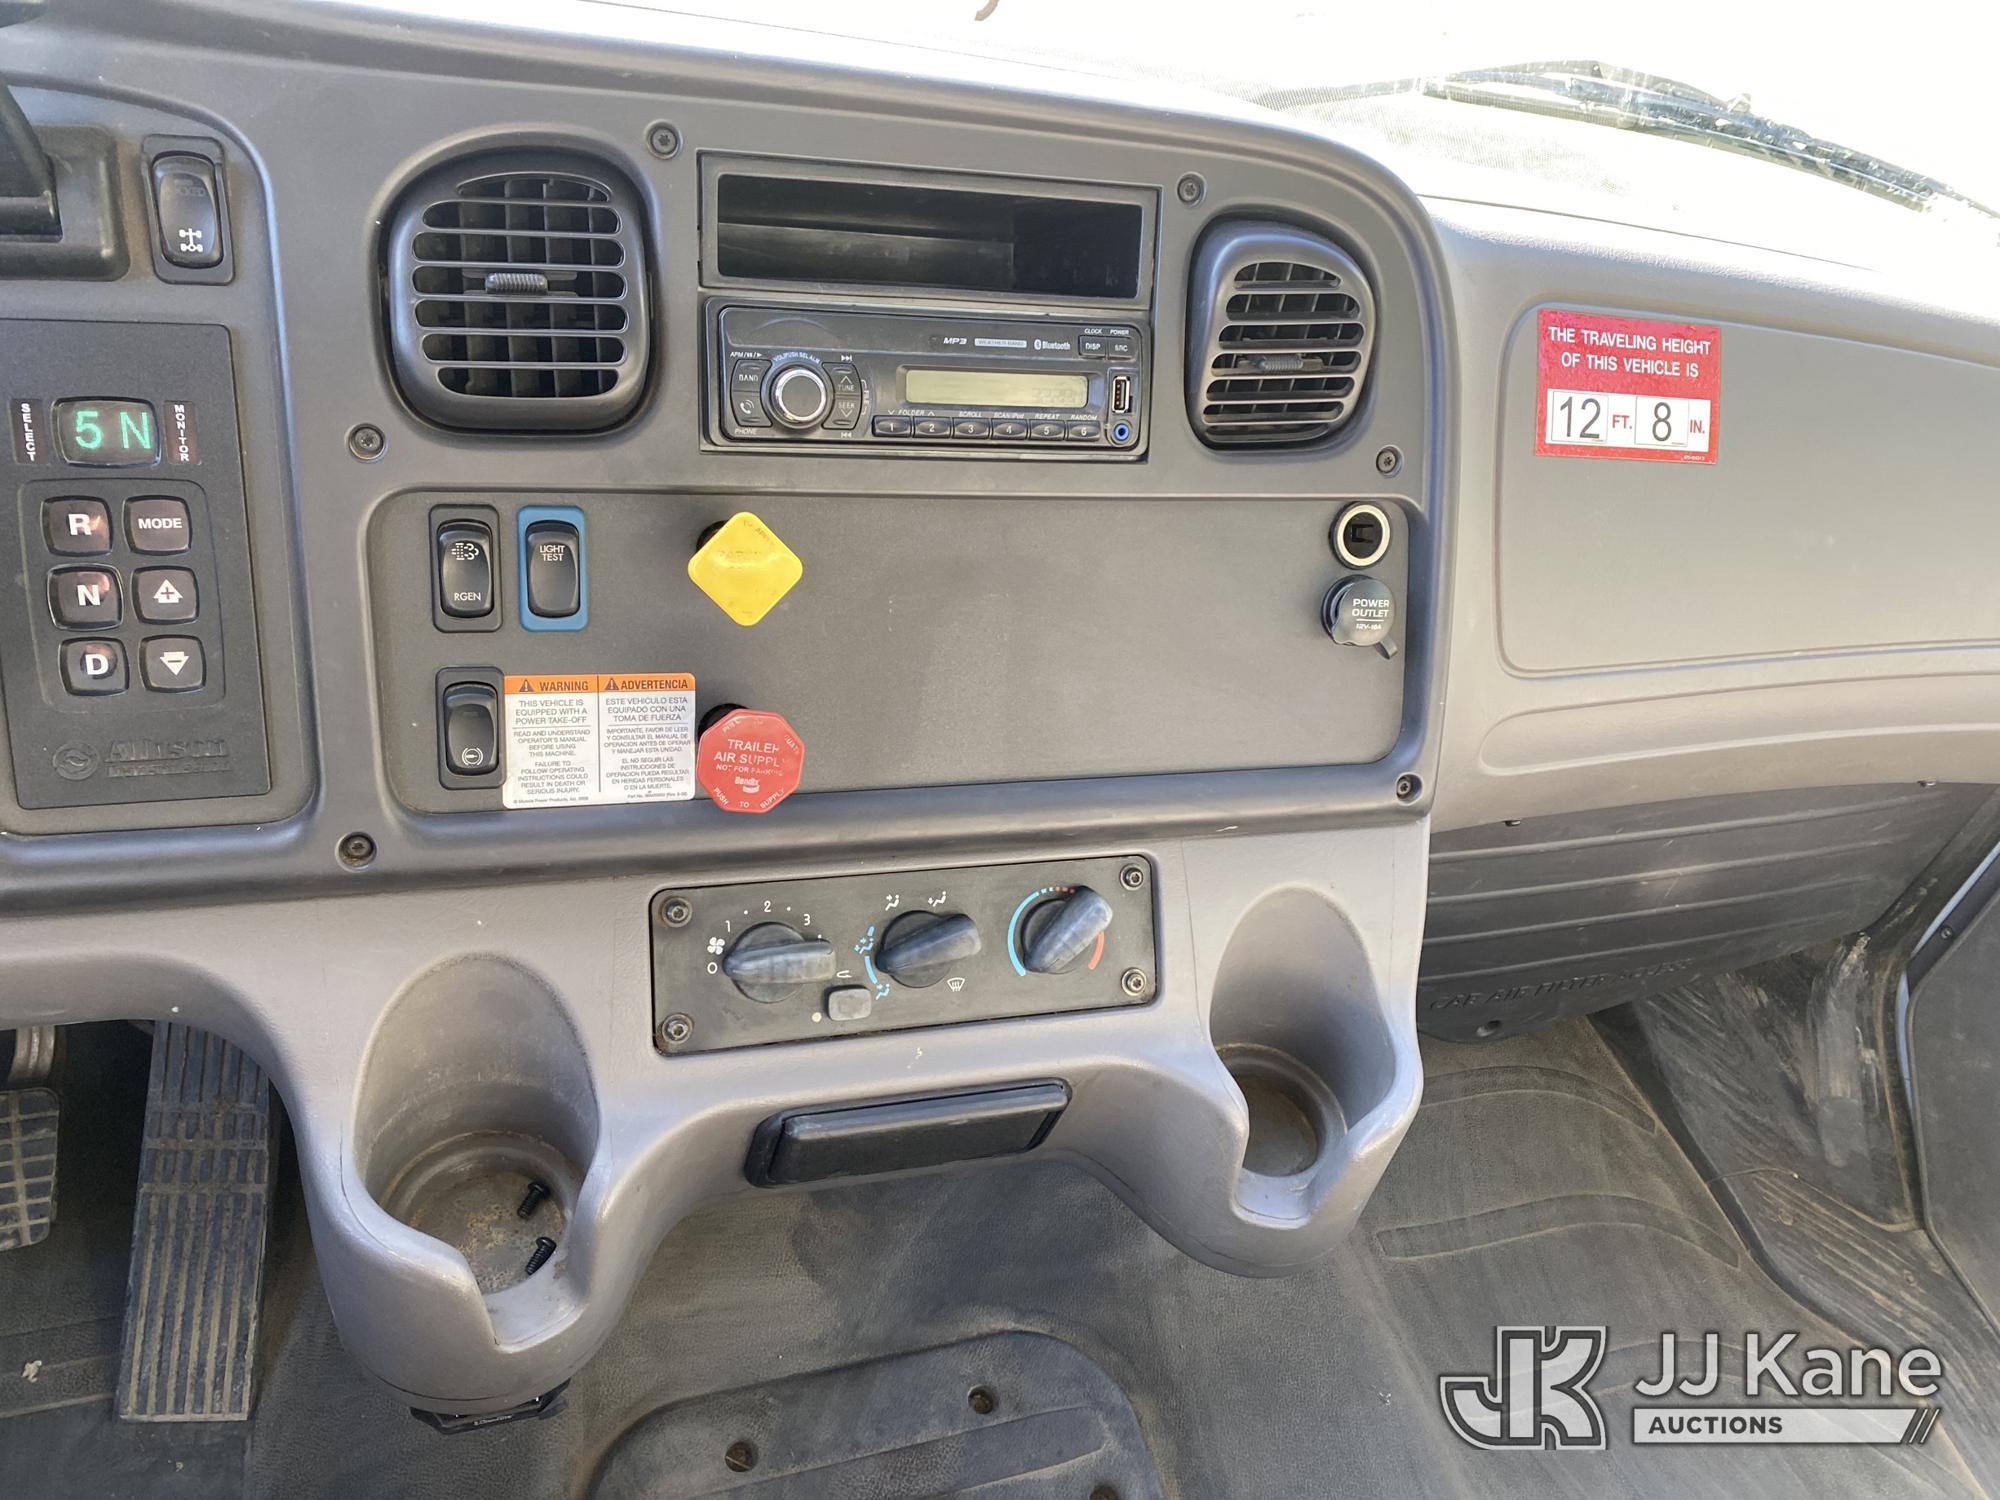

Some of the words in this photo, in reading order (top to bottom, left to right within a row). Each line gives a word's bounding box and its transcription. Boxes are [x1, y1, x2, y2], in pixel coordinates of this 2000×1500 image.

[943, 337, 967, 345] MP3
[1548, 326, 1575, 343] THE
[1581, 330, 1657, 351] TRAVELING
[1662, 338, 1711, 355] HEIGHT
[1042, 341, 1071, 350] Bluetooth
[1085, 342, 1101, 350] DISP
[1561, 351, 1581, 368] OF
[1586, 354, 1617, 371] THIS
[1623, 357, 1681, 376] VEHICLE
[1686, 363, 1699, 377] IS
[738, 374, 759, 382] BAND
[838, 384, 855, 392] TUNE
[838, 401, 855, 409] SEEK
[1559, 396, 1601, 439] 12
[1611, 414, 1633, 430] FT.
[1652, 401, 1672, 442] 8
[1689, 419, 1706, 434] IN.
[75, 410, 102, 450] 5
[119, 411, 152, 449] N
[889, 422, 895, 431] 1
[928, 423, 935, 432] 2
[968, 425, 974, 433] 3
[1006, 425, 1012, 434] 4
[1043, 426, 1050, 435] 5
[21, 402, 36, 462] SELECT
[174, 404, 189, 462] MONITOR
[734, 428, 758, 436] PHONE
[1081, 427, 1087, 436] 6
[68, 513, 92, 536] R
[138, 517, 183, 529] MODE
[539, 544, 566, 553] LIGHT
[542, 553, 564, 562] TEST
[77, 584, 101, 606] N
[453, 592, 481, 601] RGEN
[1352, 598, 1390, 608] POWER
[1351, 608, 1389, 618] OUTLET
[85, 653, 109, 676] D
[539, 681, 589, 691] WARNING
[620, 679, 689, 690] ADVERTENCIA
[539, 699, 574, 707] VEHICLE
[576, 698, 584, 706] IS
[627, 697, 667, 705] VEHICULO
[668, 696, 688, 704] ESTA
[515, 708, 557, 717] EQUIPPED
[607, 706, 648, 714] EQUIPADO
[649, 705, 667, 713] CON
[515, 717, 548, 725] POWER
[549, 716, 587, 724] TAKE-OFF
[651, 713, 681, 721] FUERZA
[713, 751, 736, 763] AIR
[739, 754, 786, 768] SUPPL
[716, 763, 732, 771] NOT
[734, 765, 749, 773] FOR
[713, 787, 729, 806] PUSH
[760, 788, 785, 809] SUPPLY
[763, 901, 771, 913] 2
[803, 913, 811, 926] 3
[725, 920, 731, 932] 1
